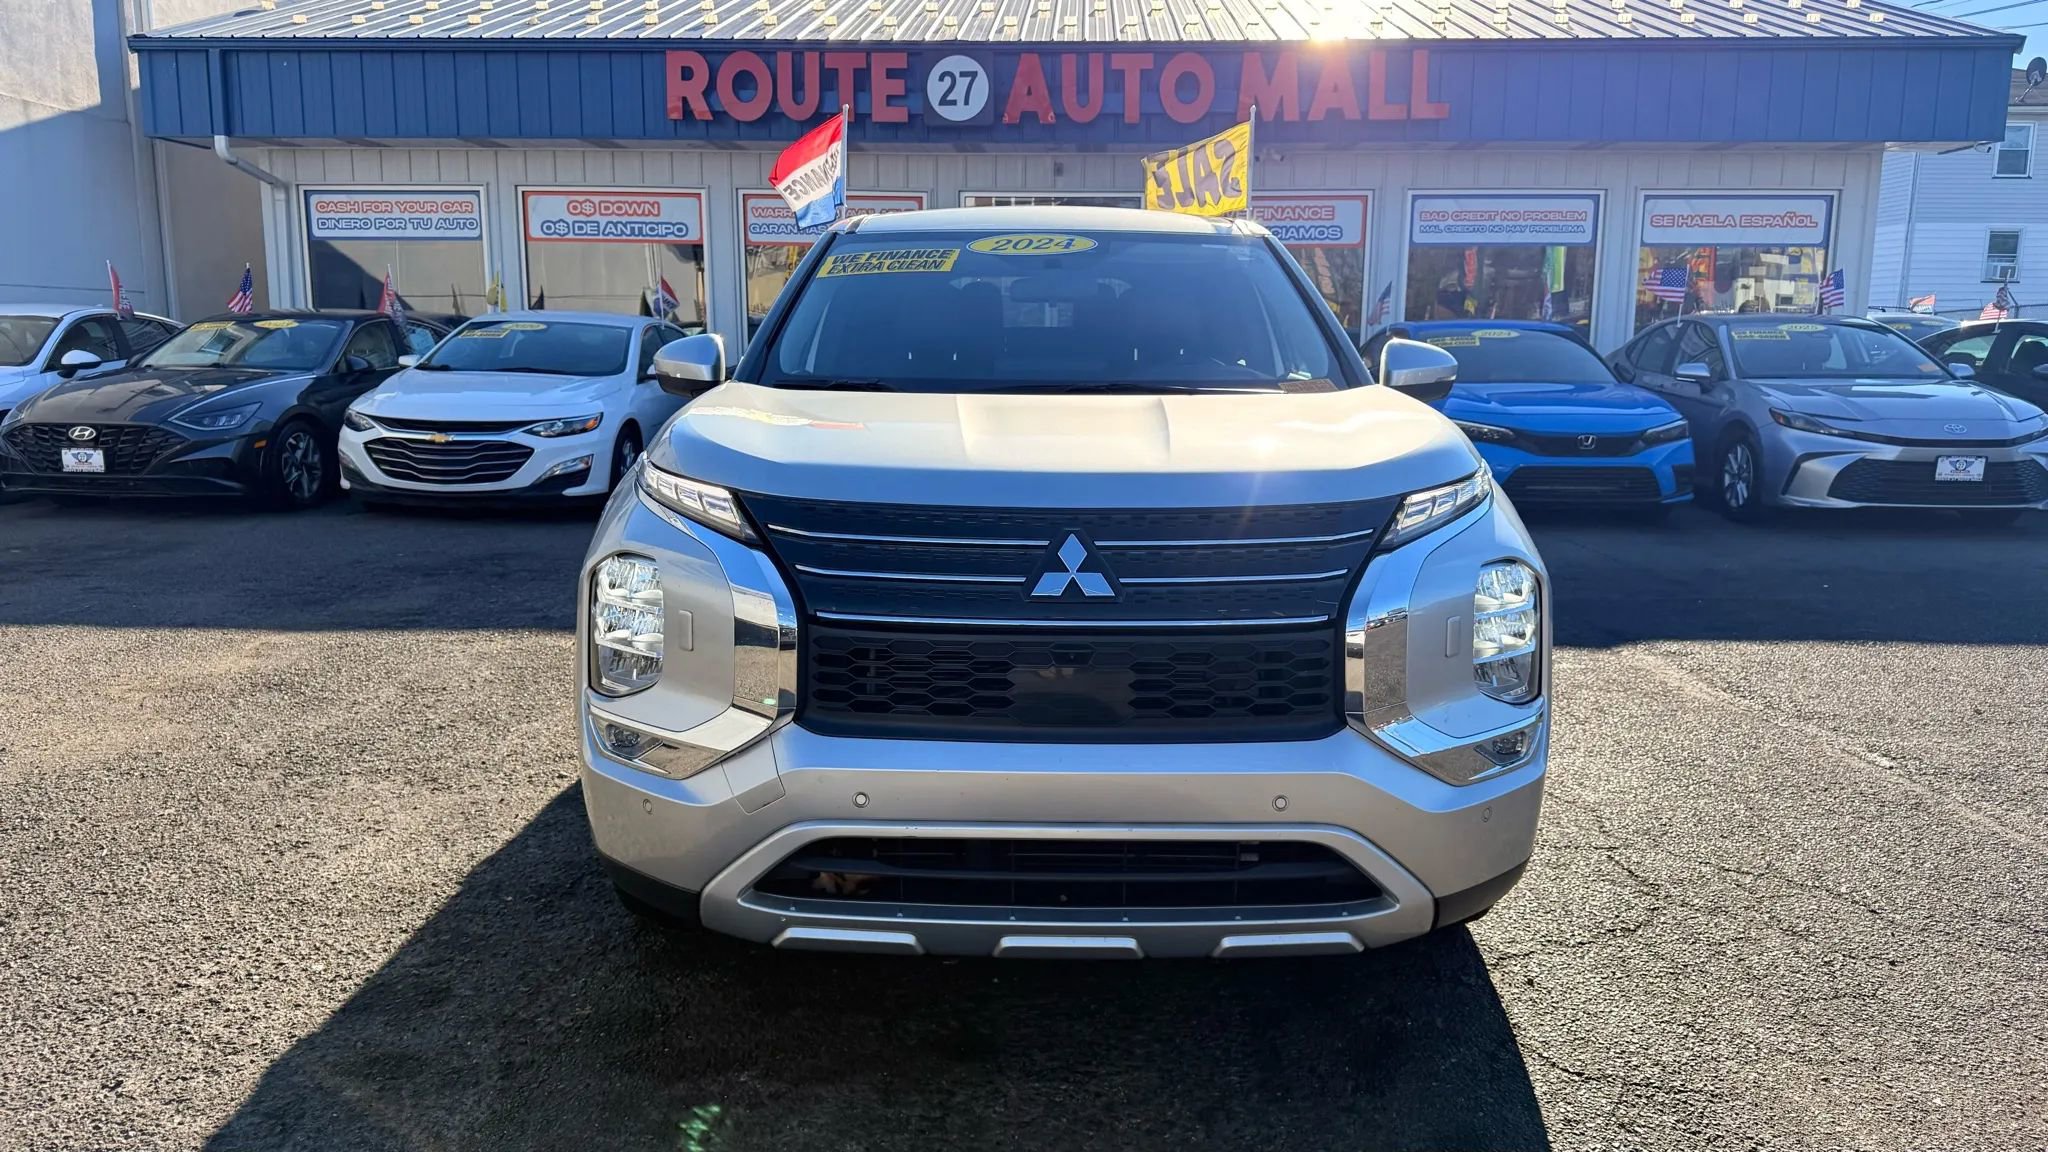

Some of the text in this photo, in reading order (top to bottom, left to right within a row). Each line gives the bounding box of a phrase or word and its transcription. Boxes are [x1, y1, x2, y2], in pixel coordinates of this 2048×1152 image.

[665, 49, 1450, 125] ROUTE 27 AUTO MALL
[316, 200, 474, 214] CASH FOR YOUR CAR
[600, 200, 660, 217] DOWN
[1253, 205, 1335, 221] FINANCE
[317, 217, 479, 230] DINERO POR TU AUTO
[1419, 211, 1587, 221] BAD CREDIT NO PROBLEM
[1651, 211, 1817, 228] SE HABLA ESPAÑOL
[572, 221, 599, 236] DE
[602, 221, 688, 238] ANTICIPO
[1269, 224, 1343, 241] CIAMOS
[1419, 225, 1586, 233] MAL CREDITO NO HAY PROBLEMA
[990, 237, 1076, 251] 2024
[831, 249, 955, 265] WE FINANCE
[826, 260, 947, 275] EXTRA CLEAN
